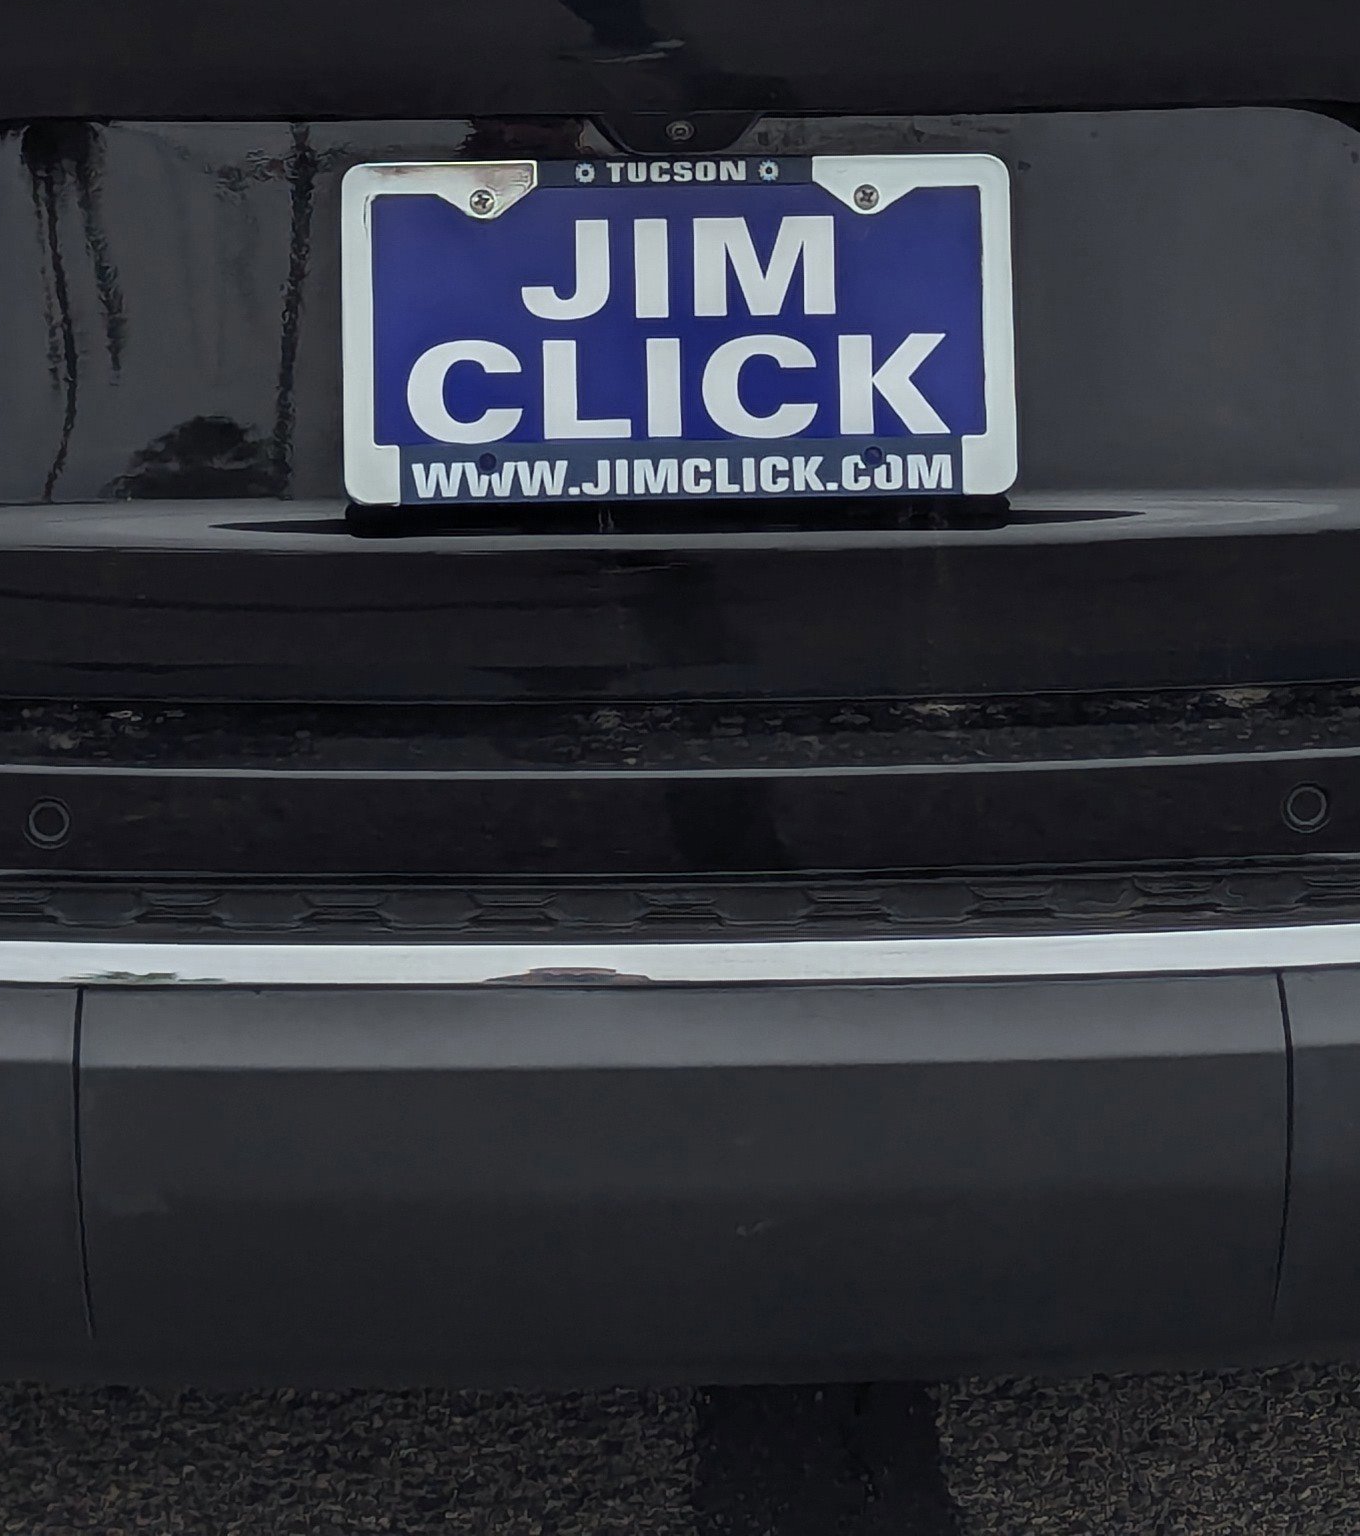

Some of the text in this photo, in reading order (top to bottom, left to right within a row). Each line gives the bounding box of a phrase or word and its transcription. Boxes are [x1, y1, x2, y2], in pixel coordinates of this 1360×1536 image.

[605, 160, 747, 184] TUCSON
[521, 215, 837, 321] JIM
[406, 332, 952, 445] CLICK
[411, 453, 954, 499] WWW.JIMCLICK.COM
